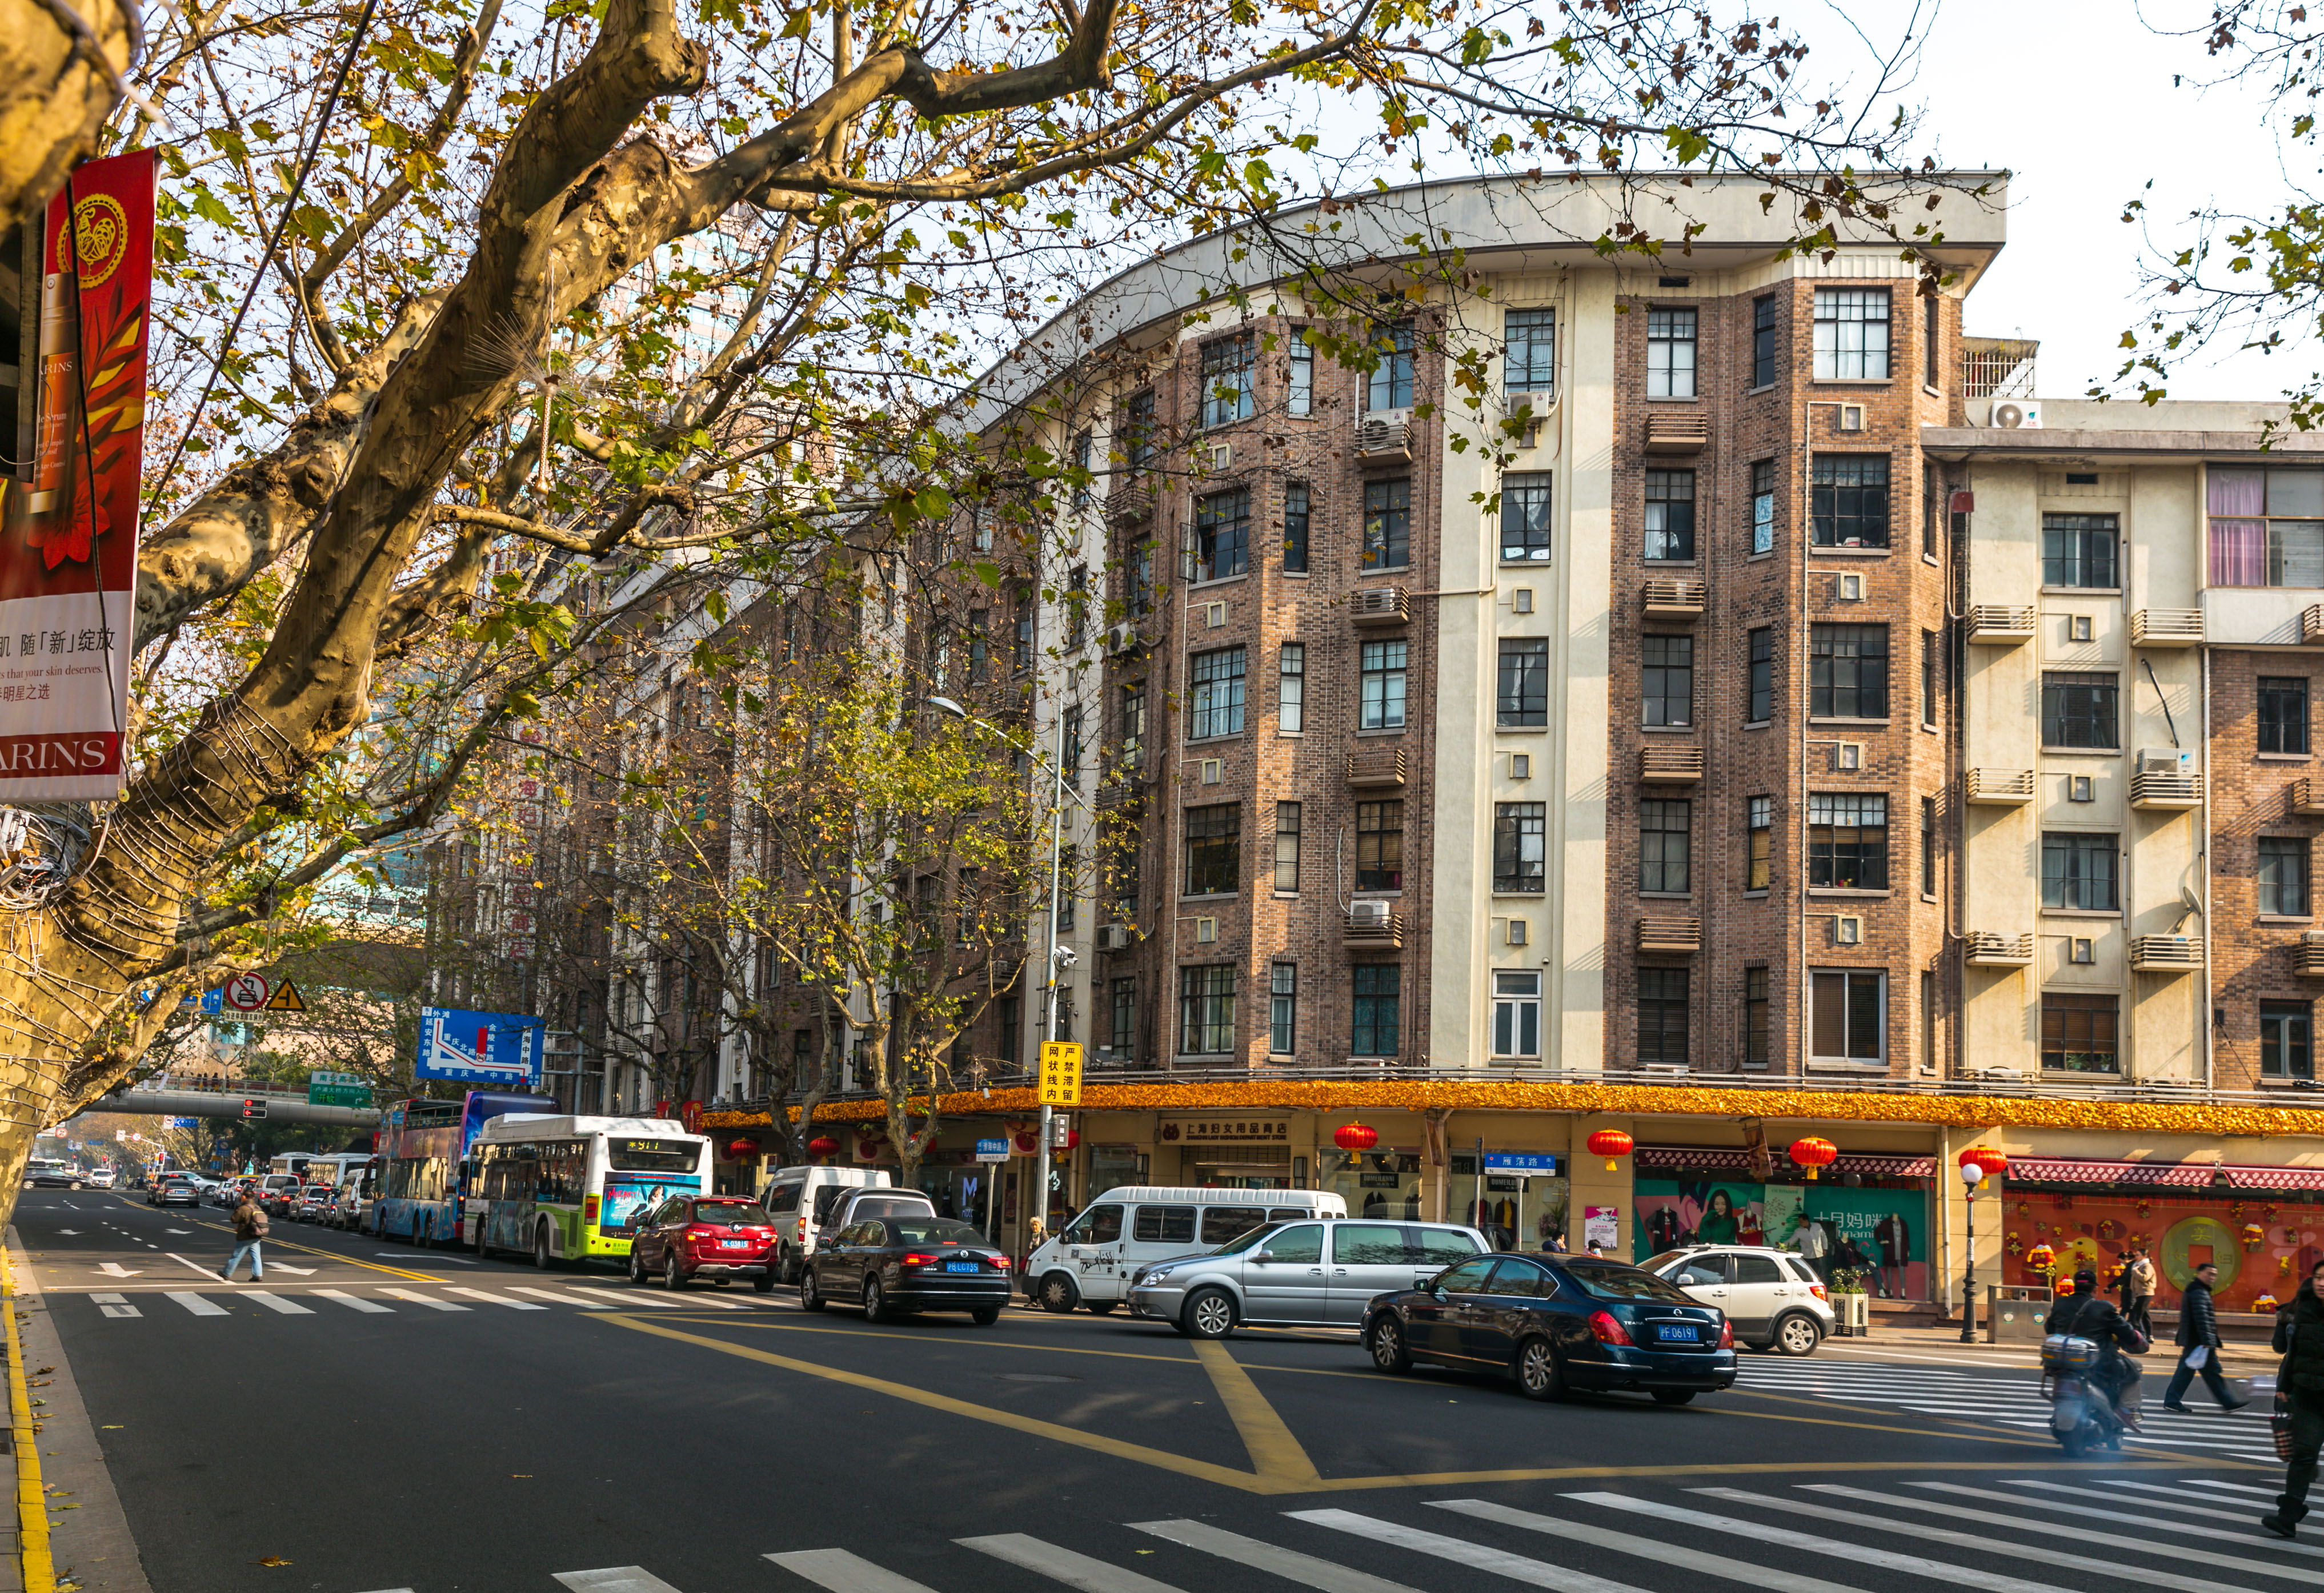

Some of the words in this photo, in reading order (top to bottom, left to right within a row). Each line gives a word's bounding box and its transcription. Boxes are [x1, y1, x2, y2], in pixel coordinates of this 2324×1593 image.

[7, 669, 23, 679] that
[25, 669, 44, 680] your
[46, 666, 62, 676] skin
[65, 665, 103, 675] deserves.
[432, 1010, 450, 1018] 外滩
[422, 1018, 434, 1057] 延安东路
[443, 1033, 476, 1056] 重庆北路
[486, 1024, 497, 1061] 金陵西路
[521, 1026, 532, 1064] 淮海中路
[1047, 1046, 1059, 1100] 网状线内
[1063, 1048, 1075, 1101] 严禁滞留
[318, 1094, 335, 1104] 开放
[1186, 1123, 1287, 1134] 上海妇女用品商店
[1502, 1157, 1538, 1166] 雁荡路
[1814, 1211, 1883, 1229] 十月妈咪
[1838, 1229, 1874, 1238] tmami
